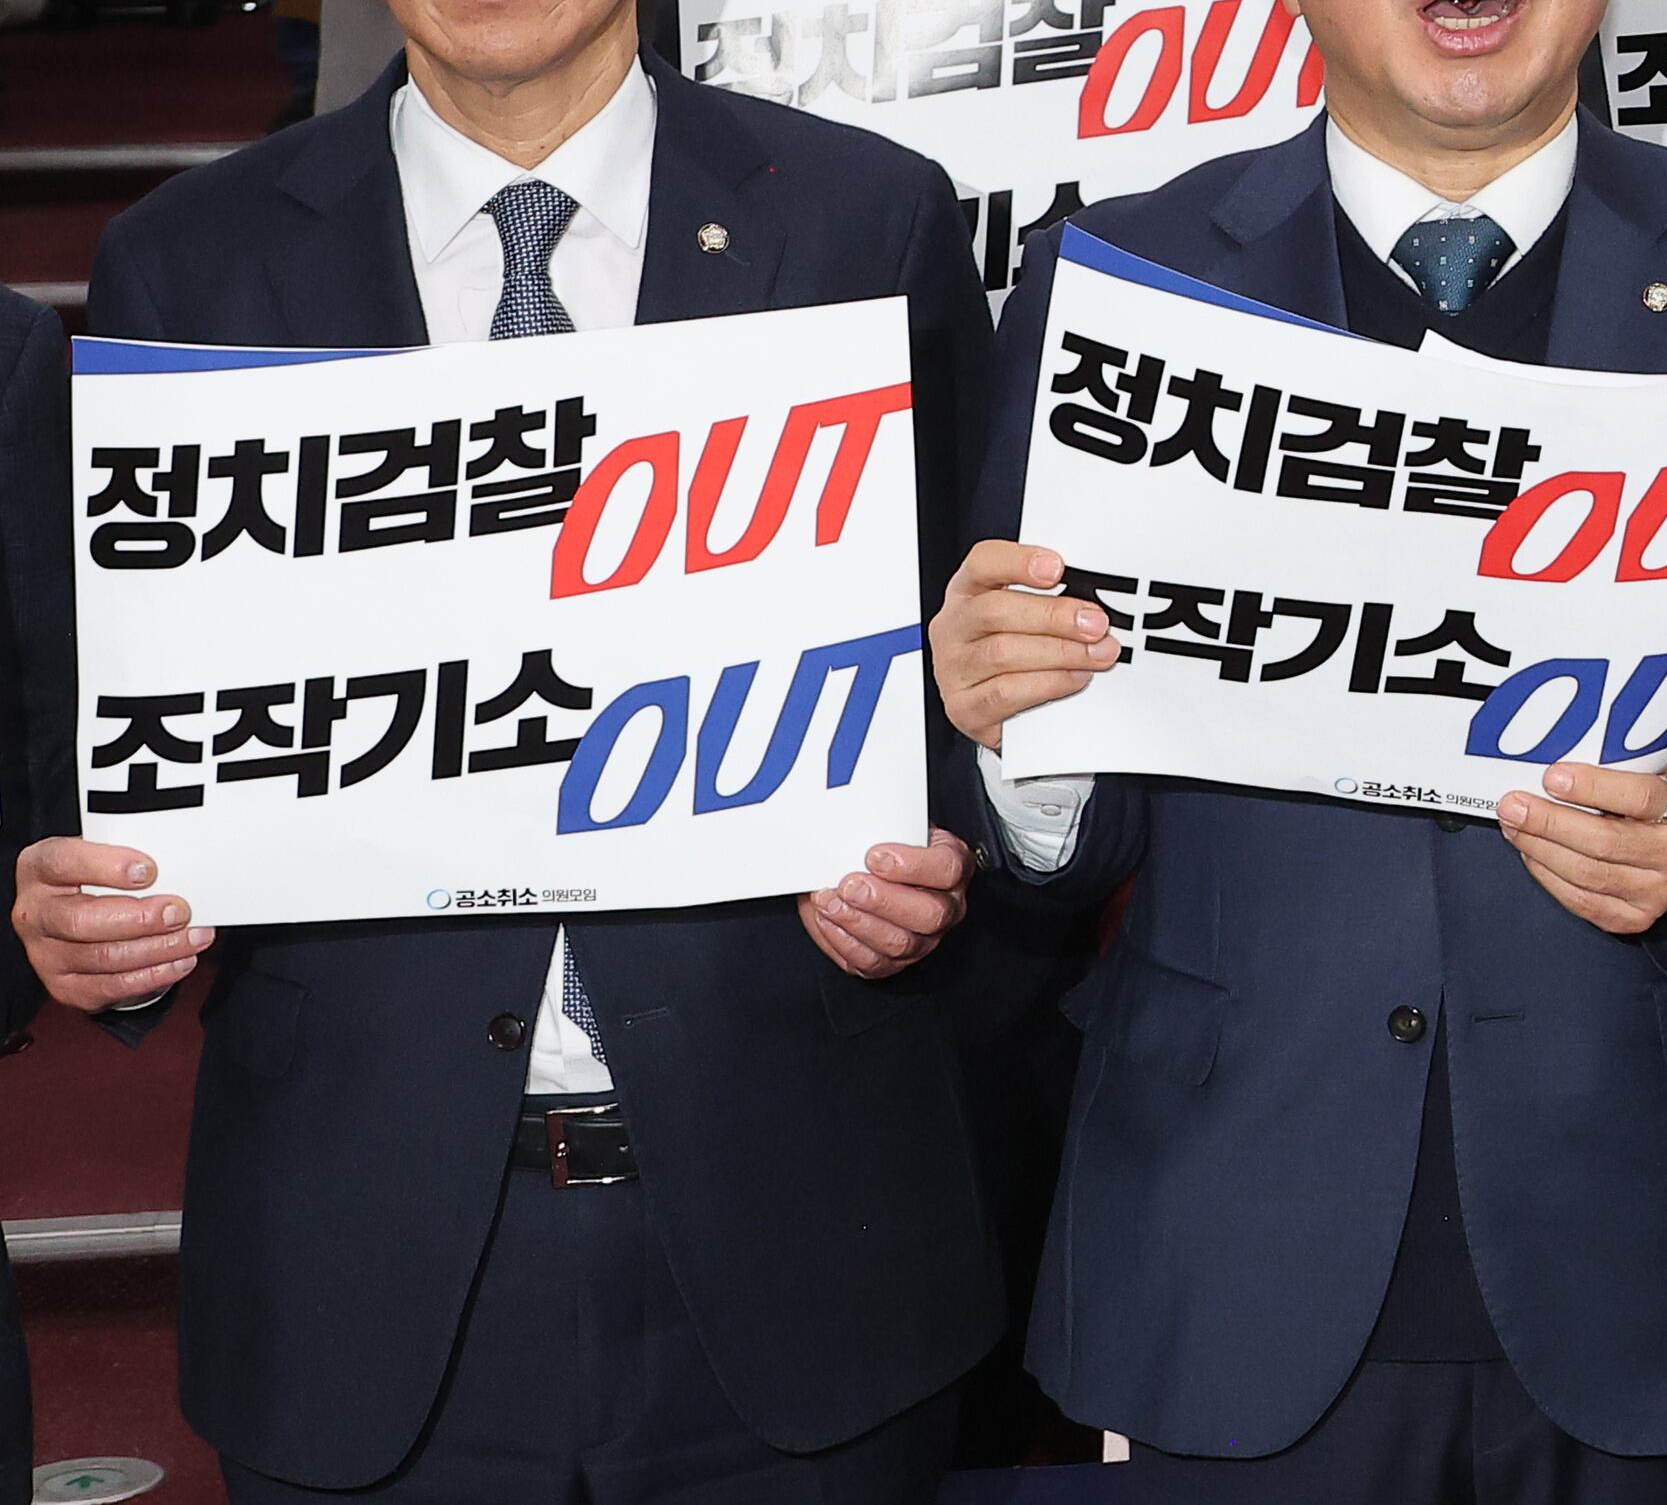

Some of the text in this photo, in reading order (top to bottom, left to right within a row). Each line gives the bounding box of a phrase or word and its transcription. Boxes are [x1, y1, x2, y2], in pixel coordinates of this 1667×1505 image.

[86, 381, 913, 601] 정치검찰 OUT
[1047, 331, 1542, 523] 정치검찰
[86, 622, 922, 836] 조작기소 OUT
[1361, 780, 1443, 805] 공소취소
[455, 886, 598, 909] 공소취소 의원모임
